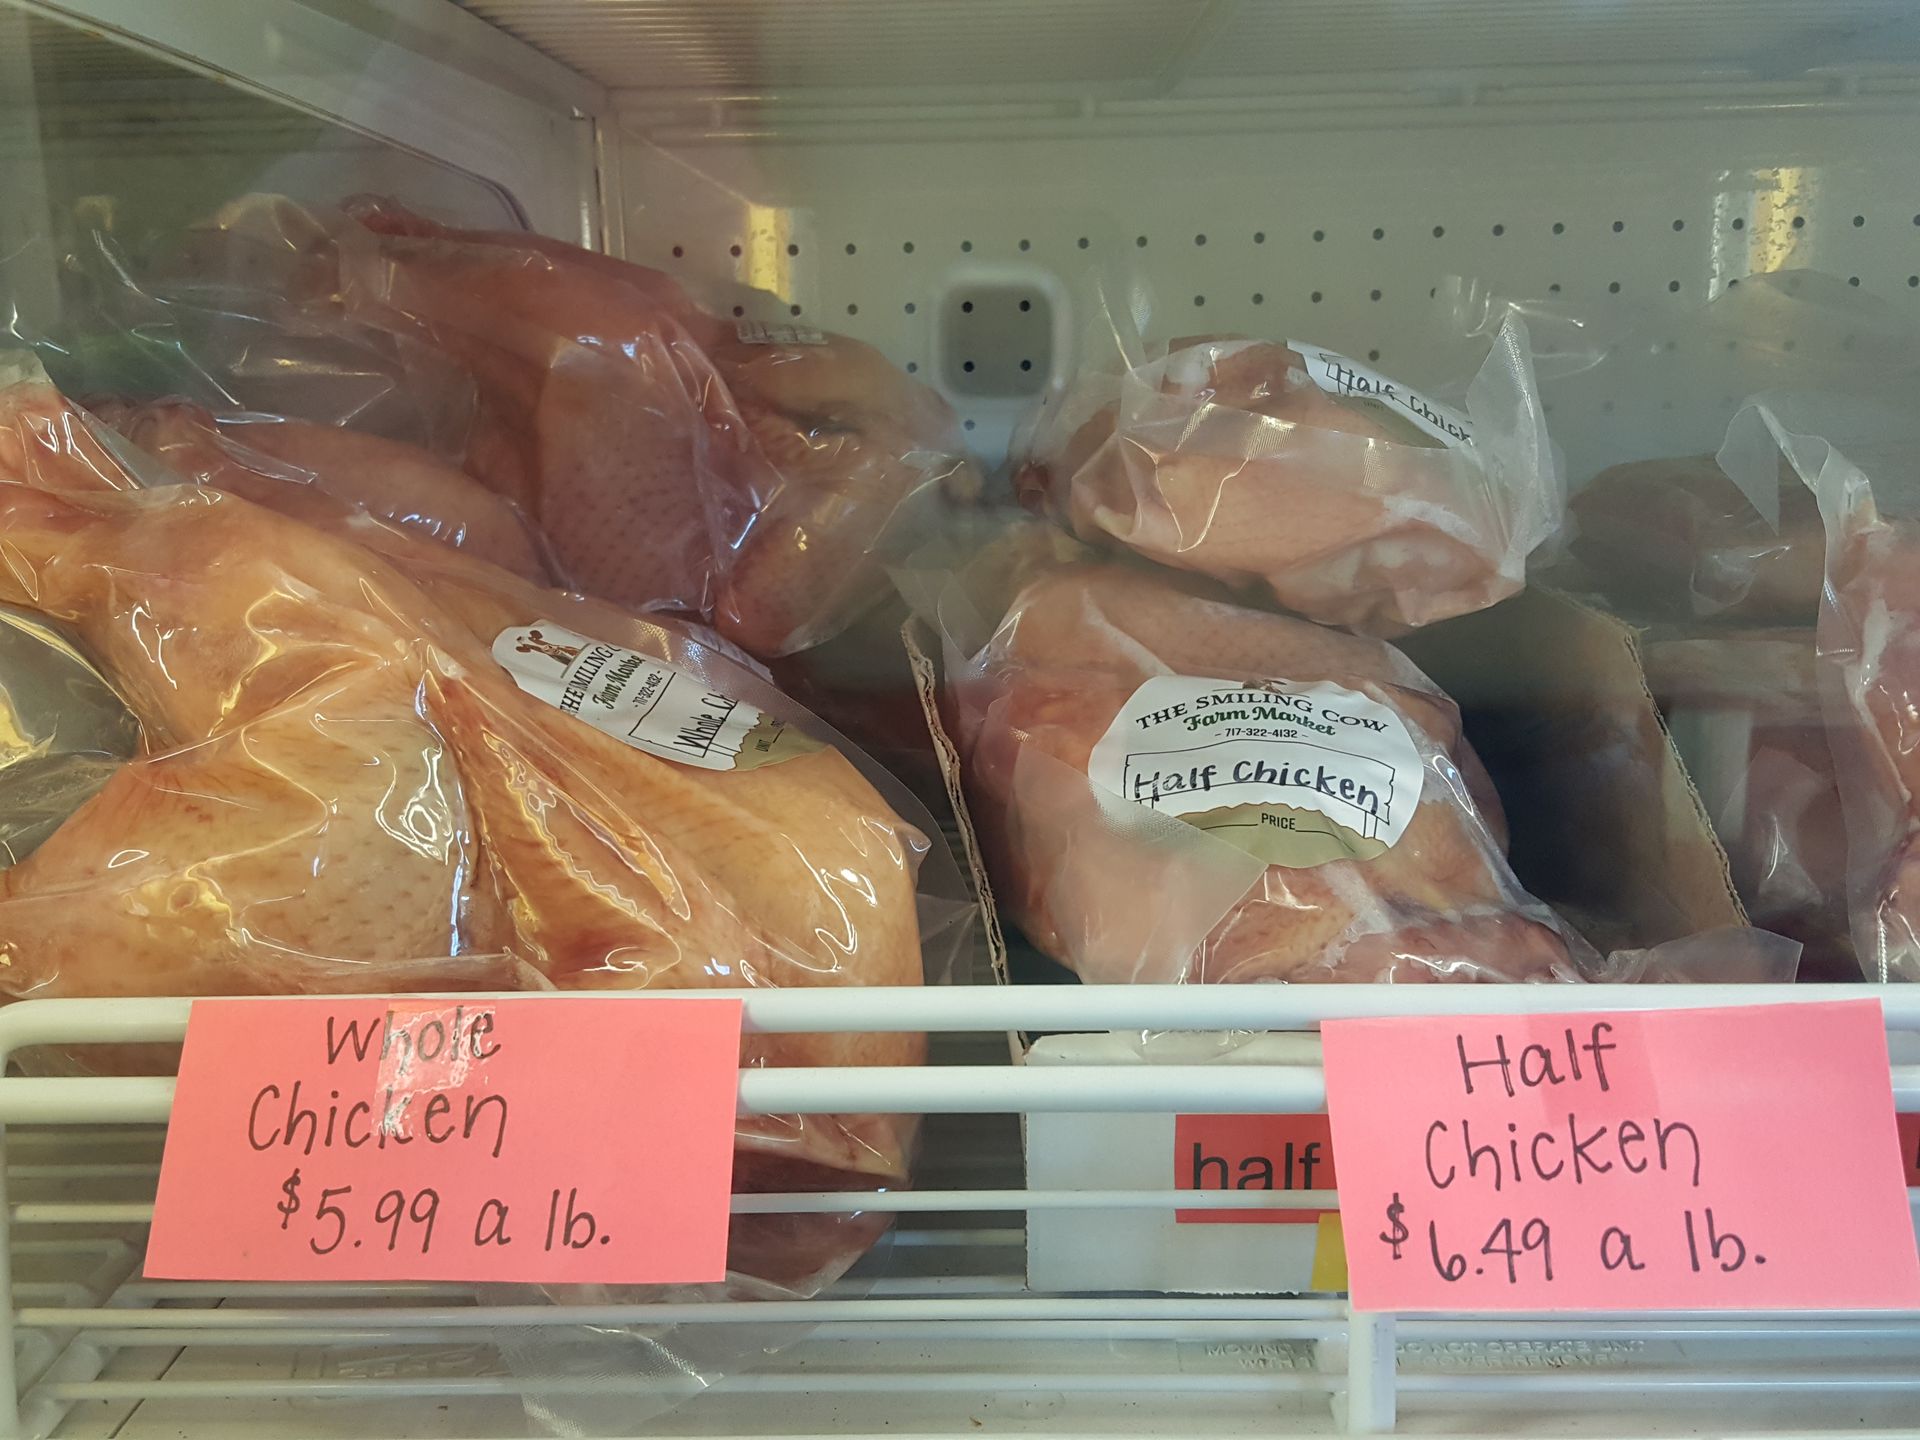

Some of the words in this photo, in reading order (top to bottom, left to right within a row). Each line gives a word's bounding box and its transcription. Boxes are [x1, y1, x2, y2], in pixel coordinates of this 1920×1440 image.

[1135, 702, 1188, 730] THE
[1195, 693, 1314, 714] SMILING
[1321, 709, 1389, 733] COW
[1183, 709, 1249, 732] Farm
[1252, 706, 1336, 735] Market
[1225, 728, 1298, 738] 717-322-4132
[1134, 764, 1217, 801] Half
[1232, 759, 1380, 816] Chicken
[1260, 812, 1297, 831] PRICE
[1455, 1022, 1617, 1097] Half
[248, 1081, 508, 1158] Chicken
[1192, 1142, 1321, 1190] half
[1425, 1113, 1701, 1191] Chicken
[276, 1168, 440, 1255] $5.99
[474, 1198, 512, 1248] a
[544, 1187, 612, 1251] lb.
[1379, 1192, 1554, 1284] $6.49
[1600, 1224, 1645, 1272] a
[1684, 1207, 1767, 1273] lb.
